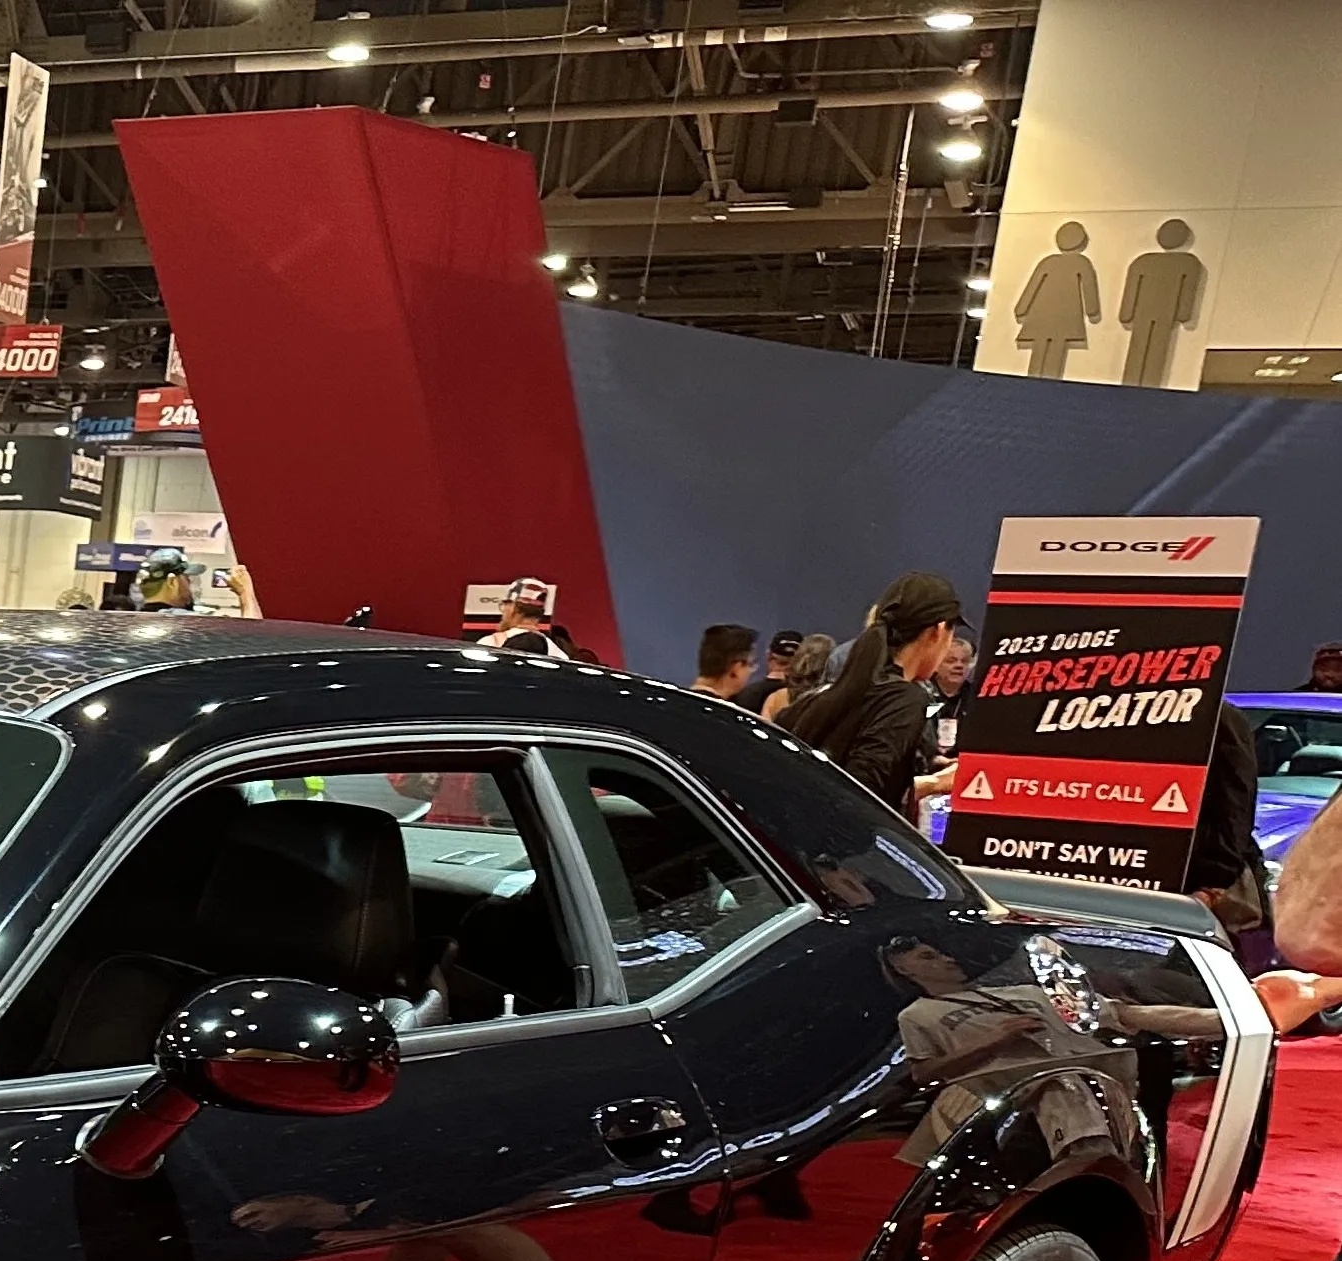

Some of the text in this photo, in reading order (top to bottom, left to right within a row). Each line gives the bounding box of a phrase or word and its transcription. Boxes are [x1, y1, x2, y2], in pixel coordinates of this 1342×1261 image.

[1040, 540, 1188, 554] DODGE
[995, 629, 1121, 656] 2023 DODGE
[978, 645, 1222, 698] HORSEPOWER
[1036, 688, 1203, 733] LOCATOR
[1005, 777, 1145, 803] IT'S LAST CALL
[984, 837, 1148, 868] DON'T SAY WE
